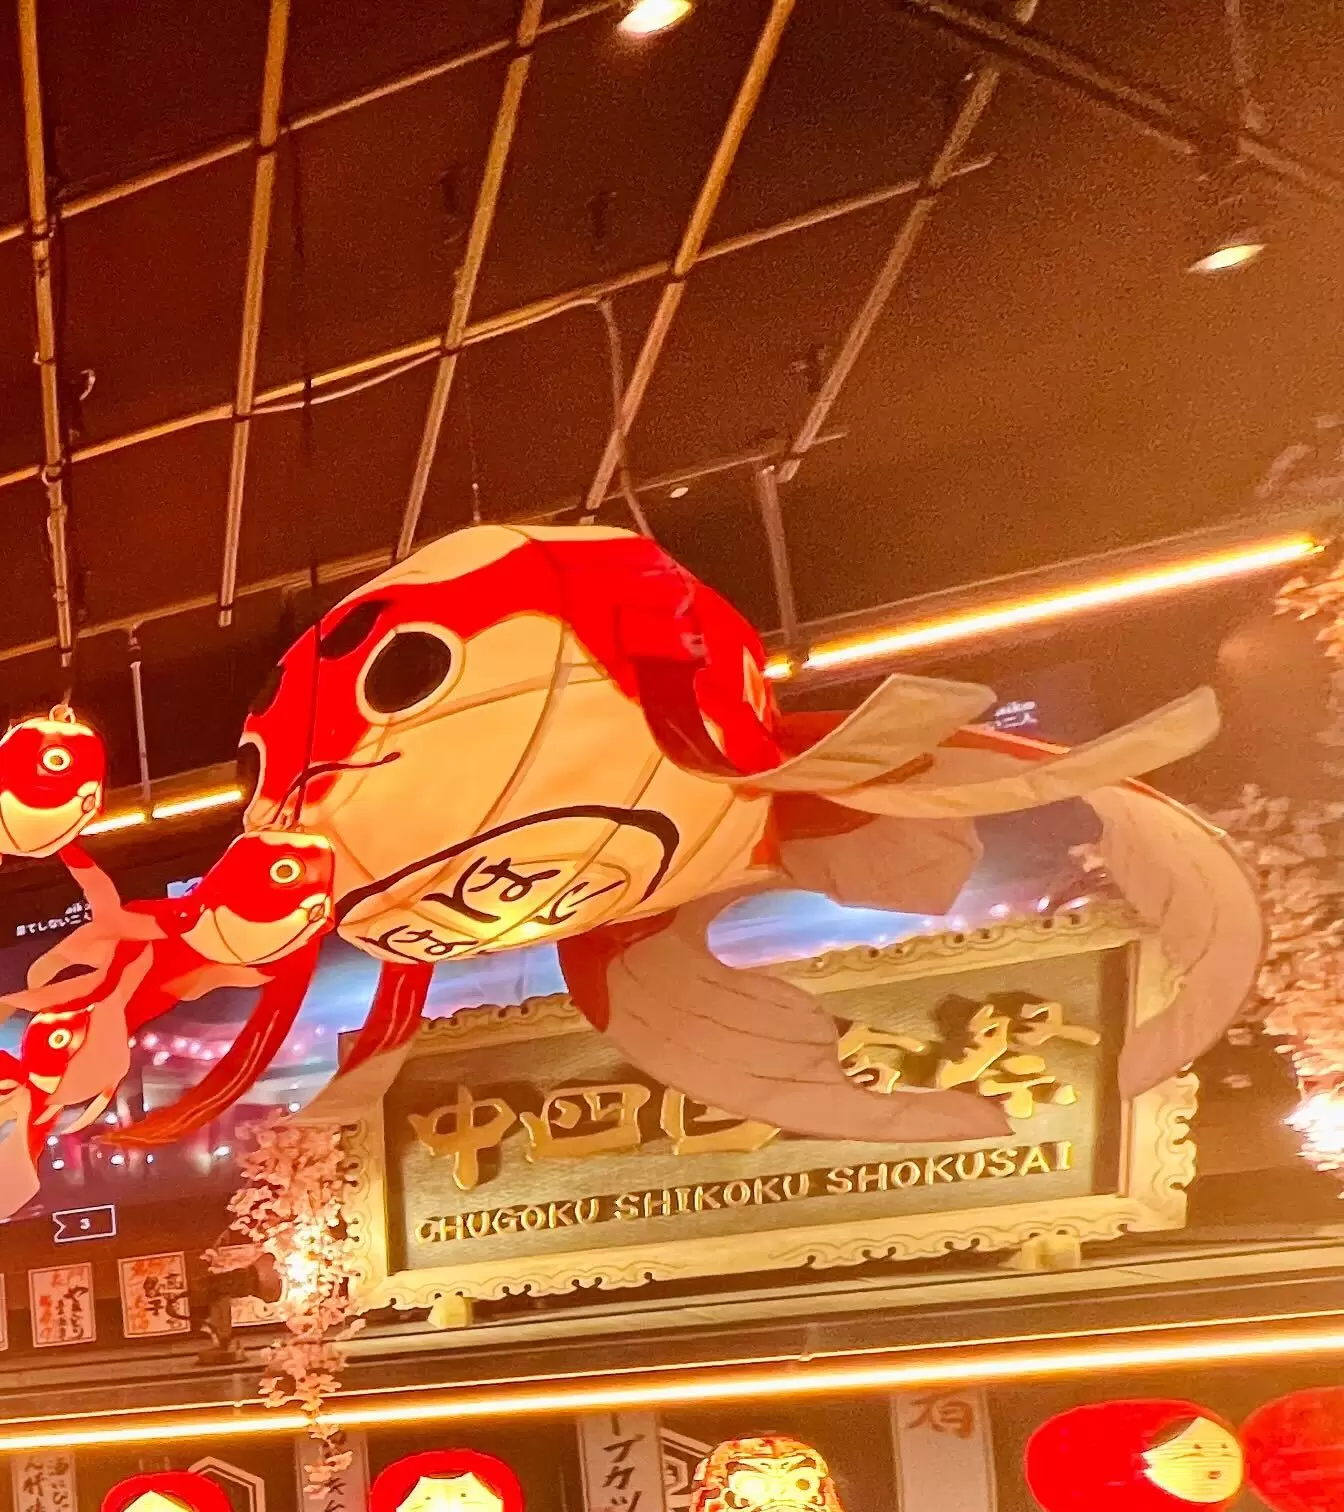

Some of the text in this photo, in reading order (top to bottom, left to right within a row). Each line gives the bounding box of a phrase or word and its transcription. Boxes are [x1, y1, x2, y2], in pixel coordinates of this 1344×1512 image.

[413, 1140, 1075, 1246] CHUGOKU SHIKOKU SHOKUSAI
